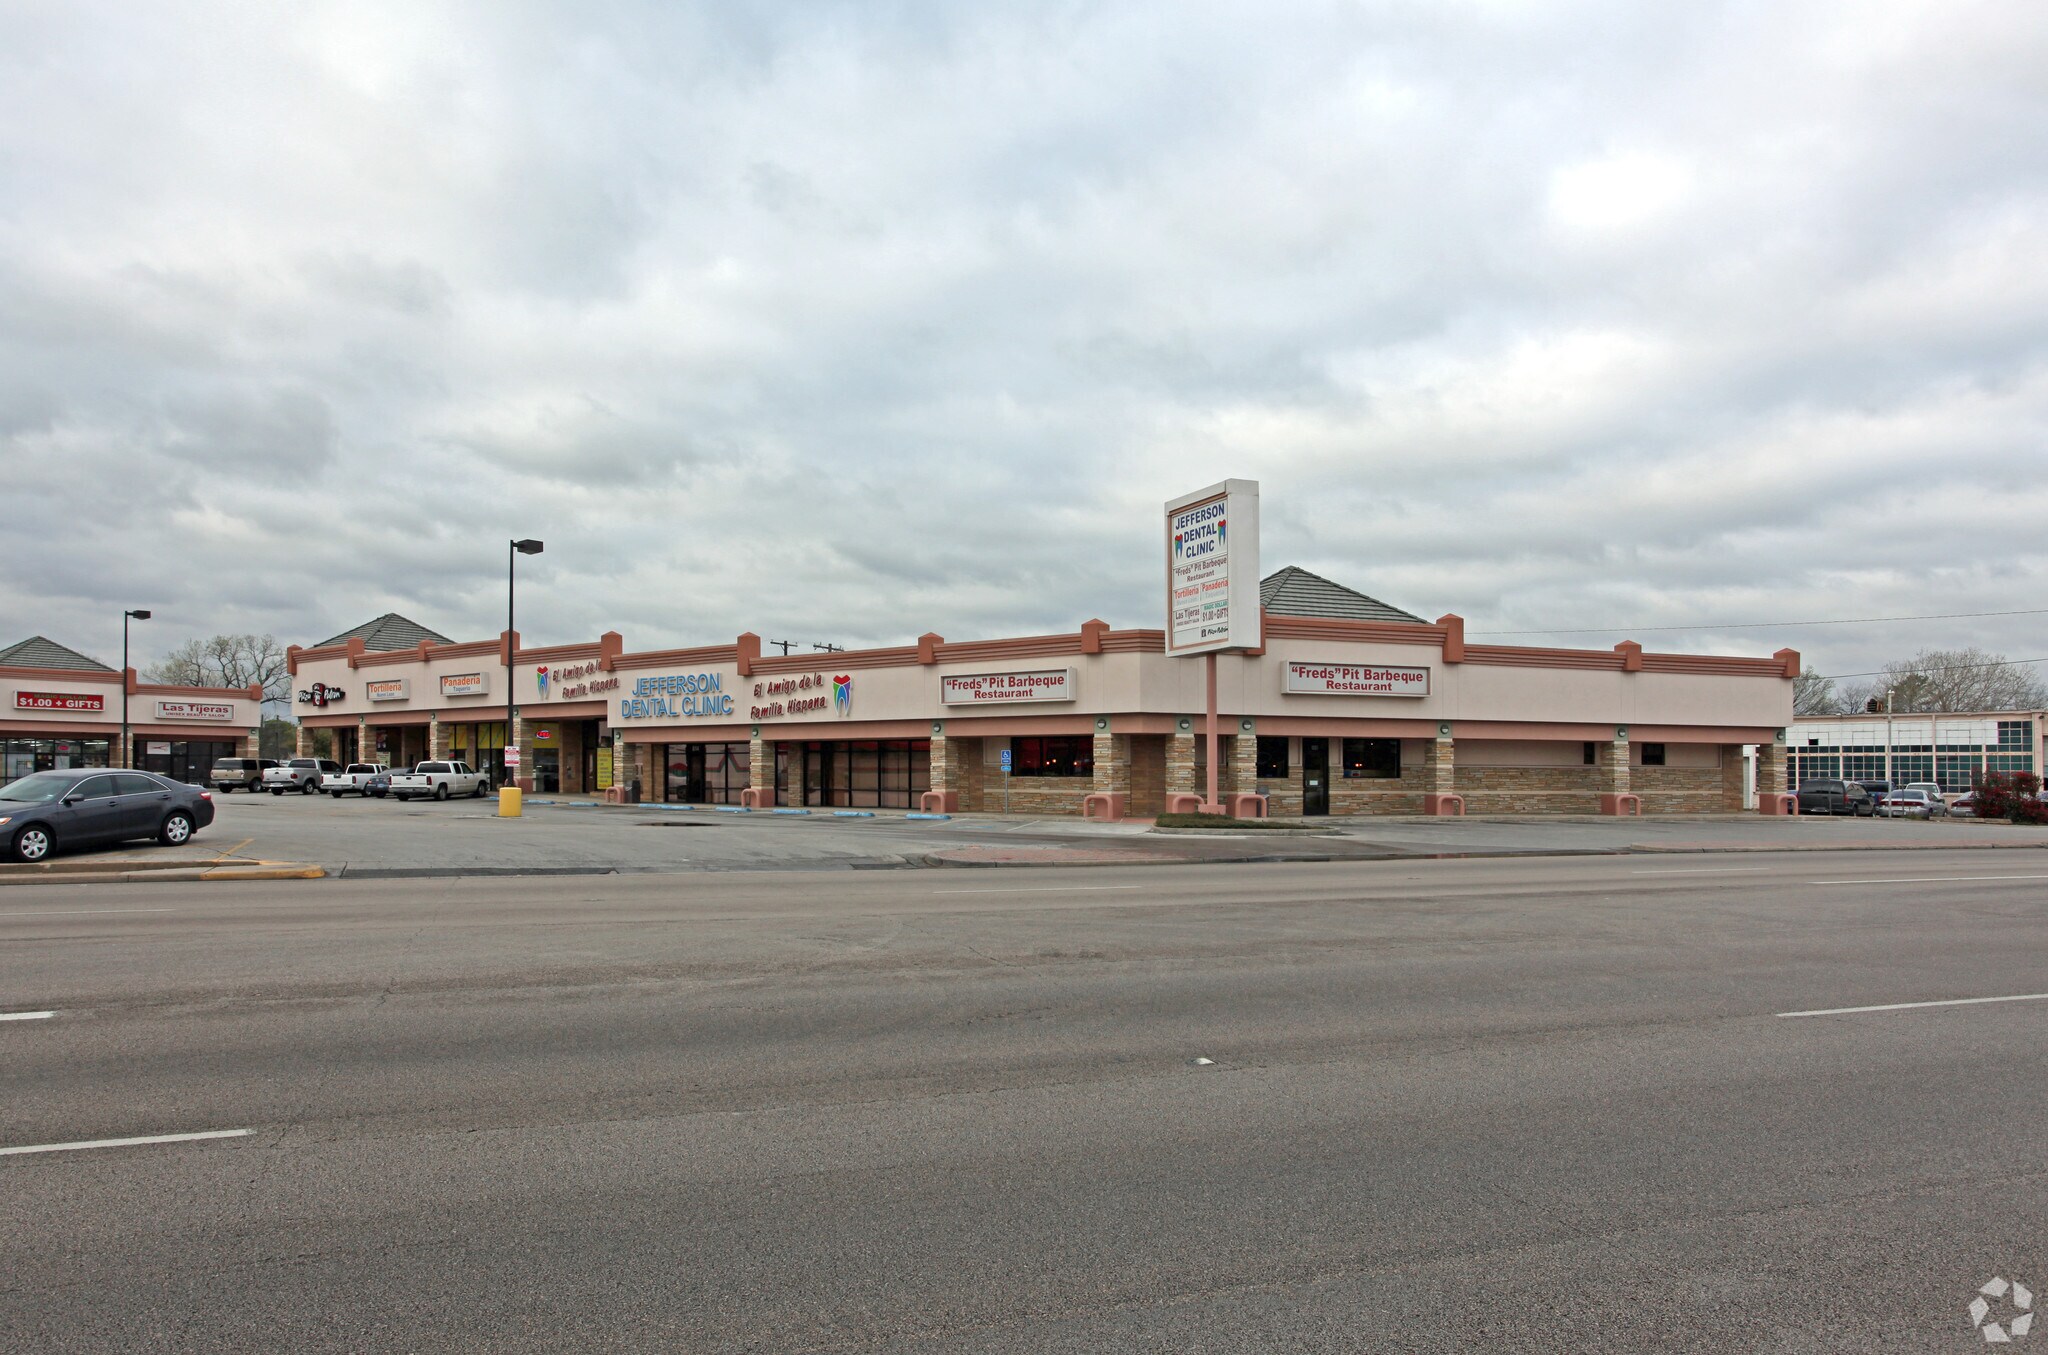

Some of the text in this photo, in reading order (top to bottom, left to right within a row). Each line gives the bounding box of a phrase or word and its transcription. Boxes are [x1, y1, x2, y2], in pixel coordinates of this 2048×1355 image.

[1175, 502, 1225, 530] JEFFERSON
[1184, 522, 1217, 543] DENTAL
[1186, 539, 1215, 558] CLINIC
[1194, 562, 1202, 572] Pit
[1203, 557, 1227, 570] Barbeque
[1186, 570, 1215, 582] Restaurant
[1202, 579, 1228, 592] Panaderia
[1175, 587, 1199, 599] Tortilleria
[1175, 608, 1200, 620] Las Tijeras
[553, 669, 559, 682] El
[562, 664, 584, 679] Amigo
[586, 661, 595, 674] de
[1342, 668, 1360, 680] Pit
[1363, 669, 1424, 684] Barbeque
[369, 682, 402, 693] Tortilleria
[443, 674, 481, 687] Panaderia
[562, 677, 618, 698] Familia Hispana
[632, 672, 721, 696] JEFFERSON
[754, 671, 823, 697] El Amigo de la
[989, 676, 1005, 688] Pit
[1008, 675, 1065, 688] Barbeque
[1326, 680, 1392, 691] Restaurant
[974, 688, 1033, 699] Restaurant
[20, 697, 52, 707] $1.00
[66, 700, 100, 709] GIFTS
[163, 703, 229, 714] Las Tijeras
[621, 694, 733, 717] DENTAL CLINIC
[751, 696, 827, 719] Familia Hispana
